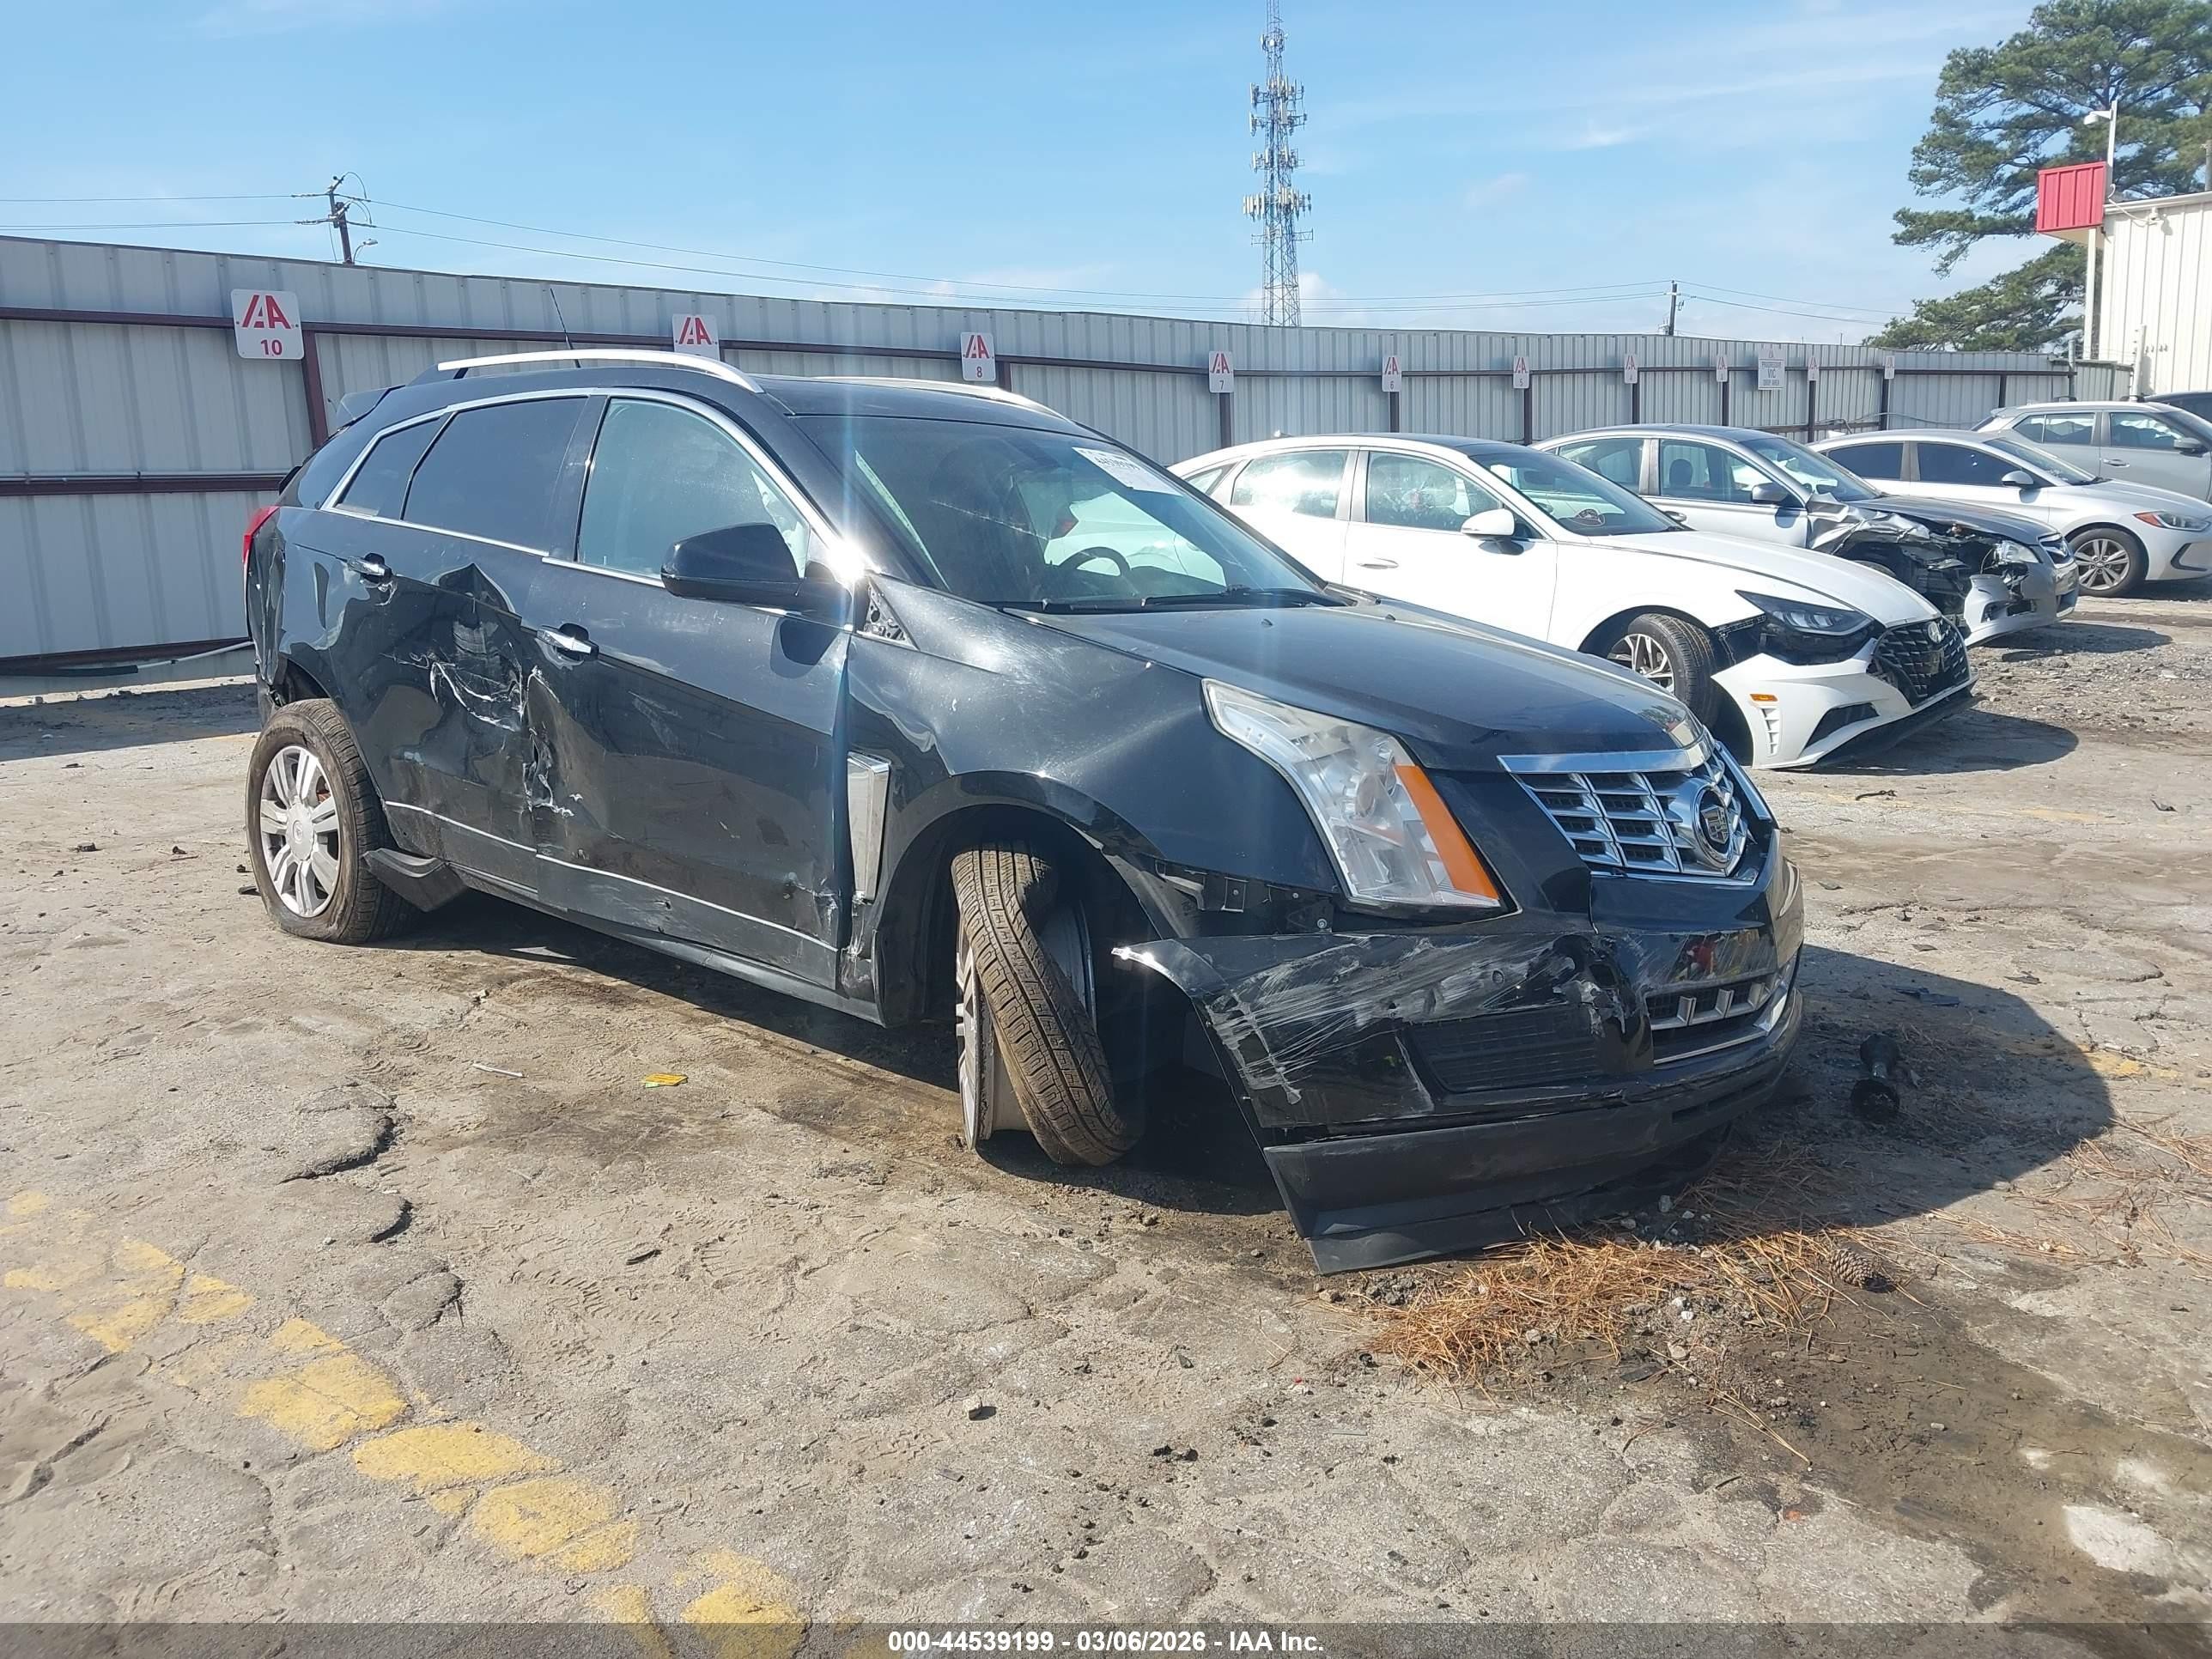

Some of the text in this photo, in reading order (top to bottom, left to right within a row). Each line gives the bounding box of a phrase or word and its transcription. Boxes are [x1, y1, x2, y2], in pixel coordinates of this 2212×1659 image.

[260, 339, 283, 356] 10
[976, 366, 983, 378] 8
[1218, 380, 1224, 391] 7
